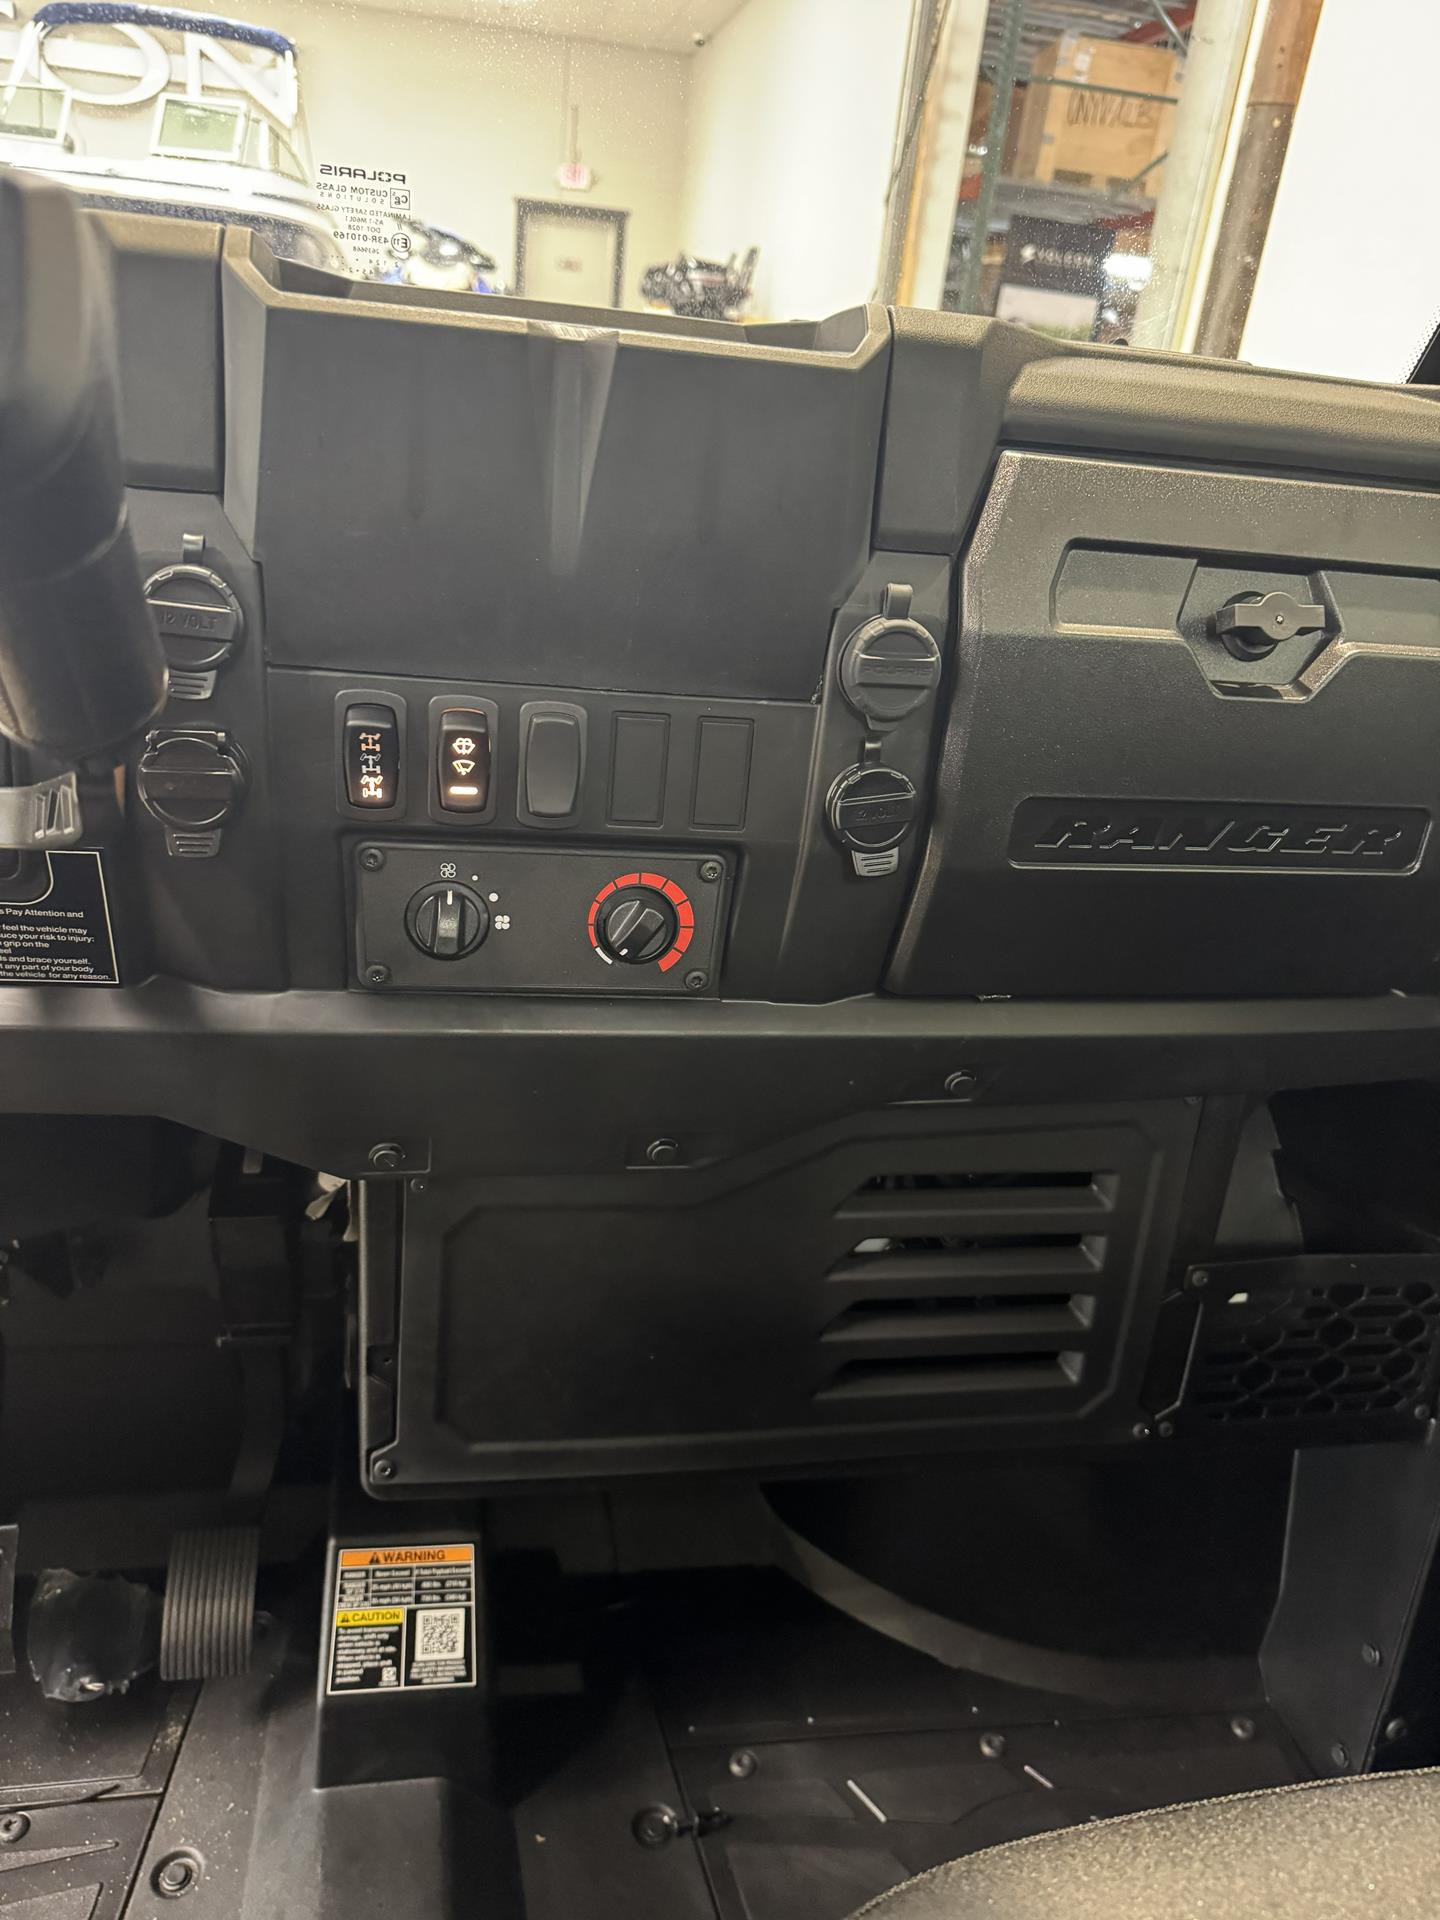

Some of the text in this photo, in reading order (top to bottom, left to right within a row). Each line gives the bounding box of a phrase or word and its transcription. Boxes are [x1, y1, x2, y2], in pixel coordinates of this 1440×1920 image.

[1033, 814, 1403, 856] RANGER
[5, 908, 23, 917] Pay
[25, 909, 66, 917] Attention
[2, 923, 19, 931] feel
[20, 924, 35, 932] the
[39, 933, 56, 941] risk
[67, 935, 95, 944] injury:
[71, 965, 95, 974] body
[383, 1549, 446, 1563] WARNING
[352, 1610, 400, 1622] CAUTION
